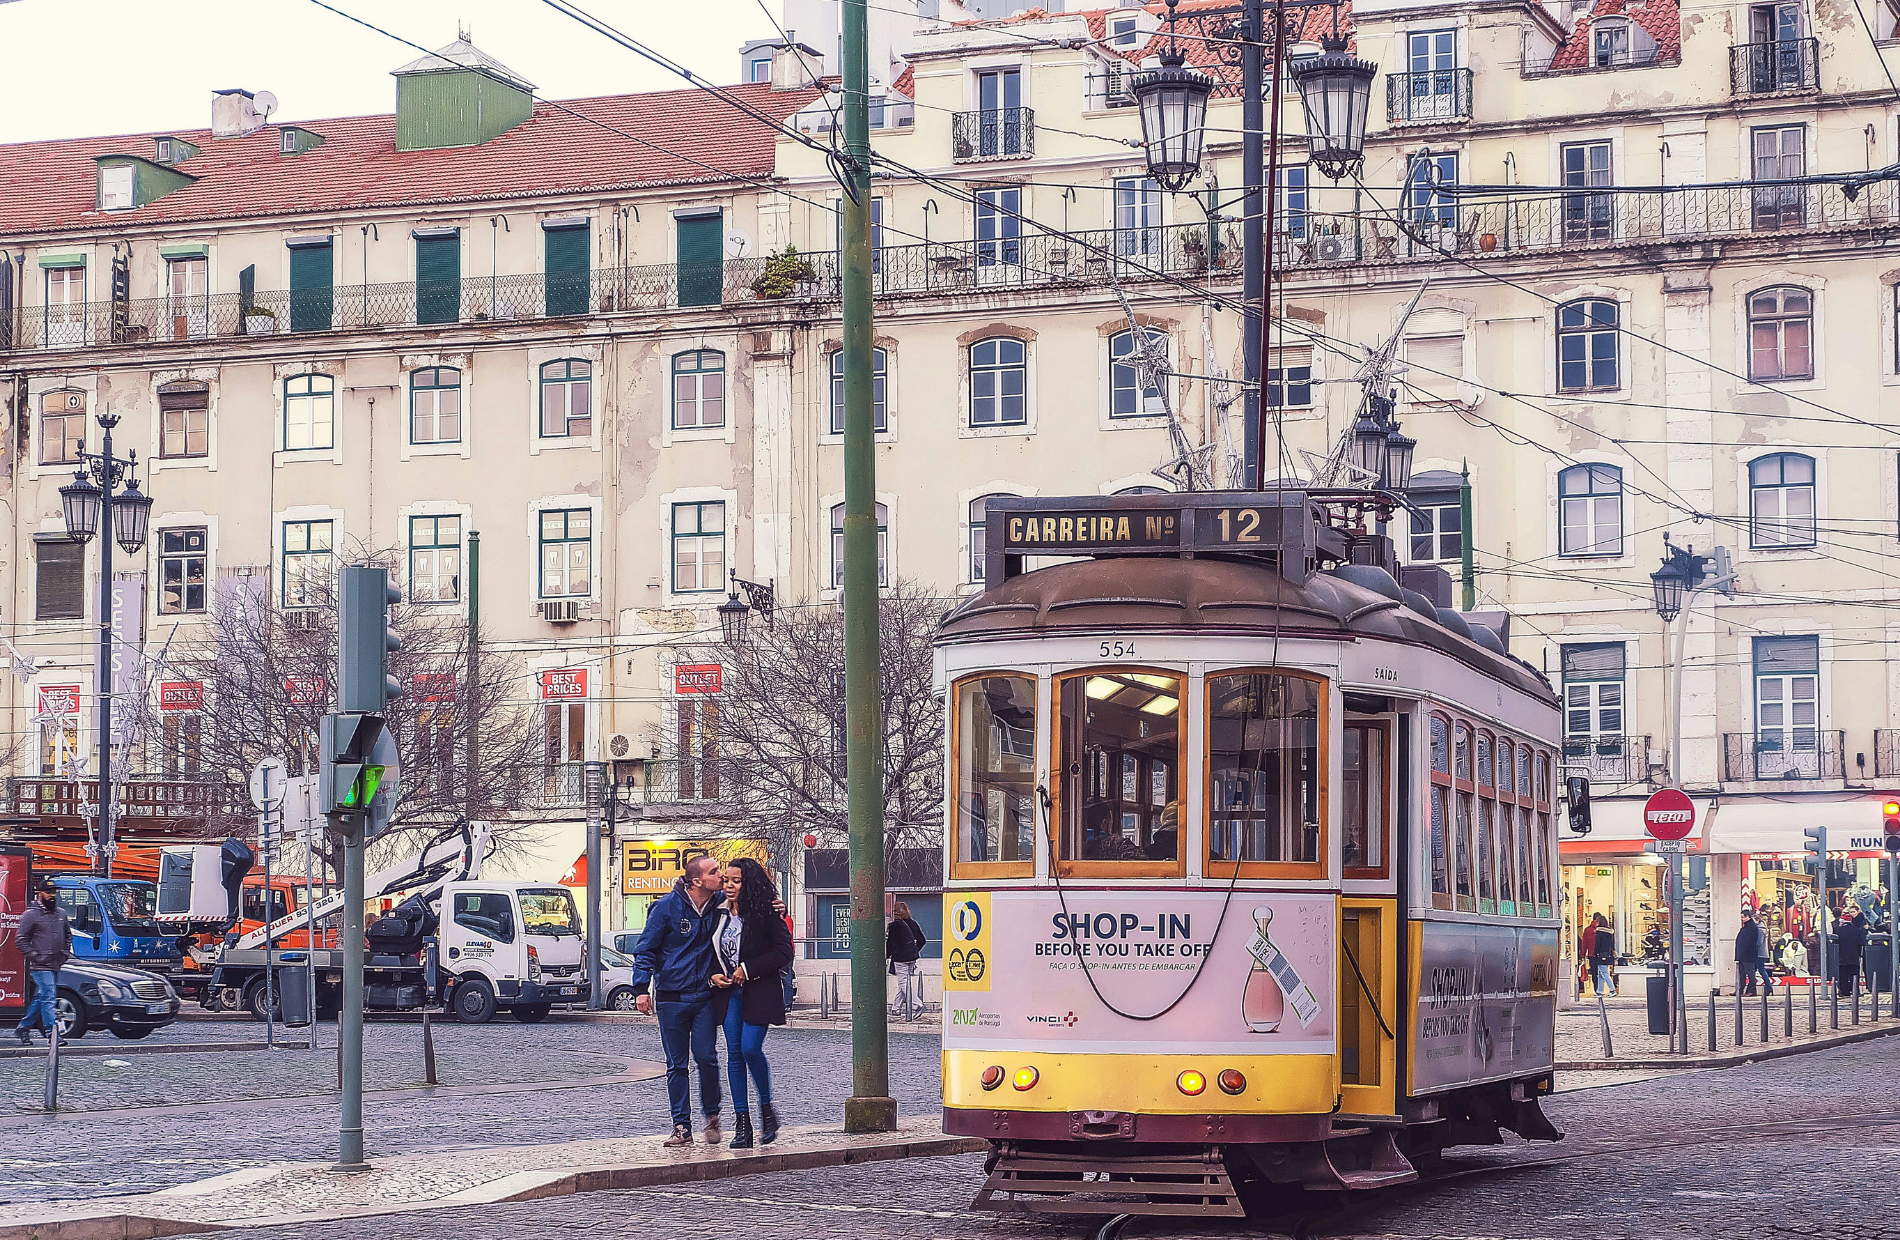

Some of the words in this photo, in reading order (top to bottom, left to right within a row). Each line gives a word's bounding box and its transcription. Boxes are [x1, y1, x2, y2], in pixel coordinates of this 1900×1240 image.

[1009, 517, 1131, 542] CARREIRA
[1217, 509, 1261, 542] 12
[1099, 641, 1136, 658] 554
[551, 673, 577, 685] BEST
[679, 673, 719, 686] OUTLET
[1374, 665, 1398, 682] SAÍDA
[547, 683, 582, 694] PRICES
[1850, 838, 1883, 848] MUN
[315, 897, 333, 909] 320
[1052, 913, 1191, 940] SHOP-IN
[1035, 943, 1091, 956] BEFORE
[1096, 943, 1130, 957] YOU
[1134, 943, 1175, 957] TAKE
[1179, 944, 1213, 957] OFF
[1049, 962, 1068, 971] FAÇA
[1111, 963, 1137, 971] ANTES
[1138, 963, 1150, 971] DE
[1151, 963, 1196, 971] EMBARCAR
[1431, 967, 1469, 1010] SHOP-IN
[984, 1020, 1001, 1028] Portugal
